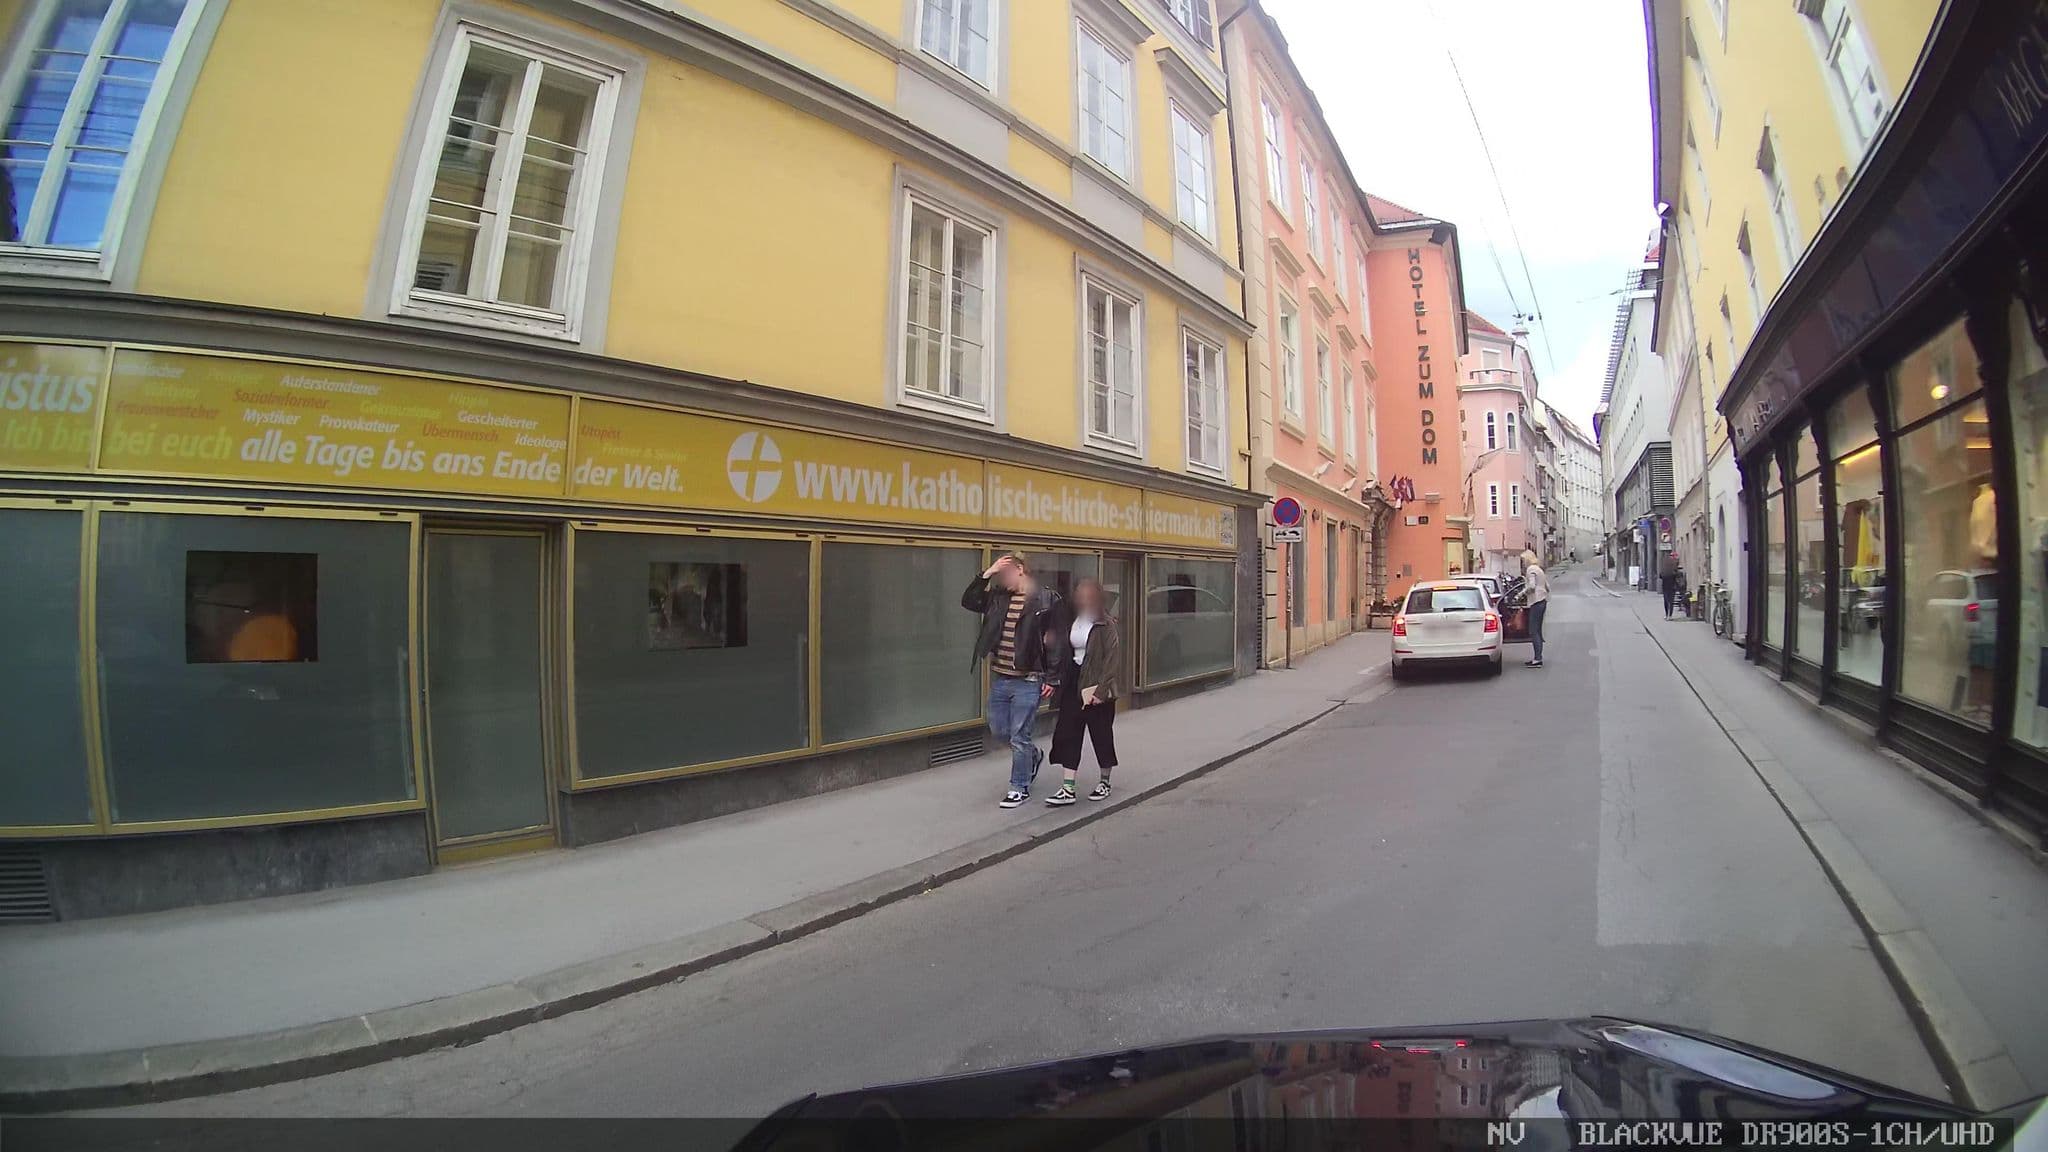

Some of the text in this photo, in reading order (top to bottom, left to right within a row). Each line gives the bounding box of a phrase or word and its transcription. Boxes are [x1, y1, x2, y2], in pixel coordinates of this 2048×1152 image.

[1407, 247, 1438, 466] HOTEL ZUM DOM
[106, 420, 157, 456] bei
[161, 425, 234, 460] euch
[241, 428, 297, 464] alle
[304, 434, 375, 477] Tage
[381, 439, 427, 473] bis
[432, 450, 486, 477] ans
[492, 450, 561, 483] Ende
[575, 457, 617, 487] der
[623, 462, 685, 493] Welt.
[319, 415, 401, 434] Provokateur
